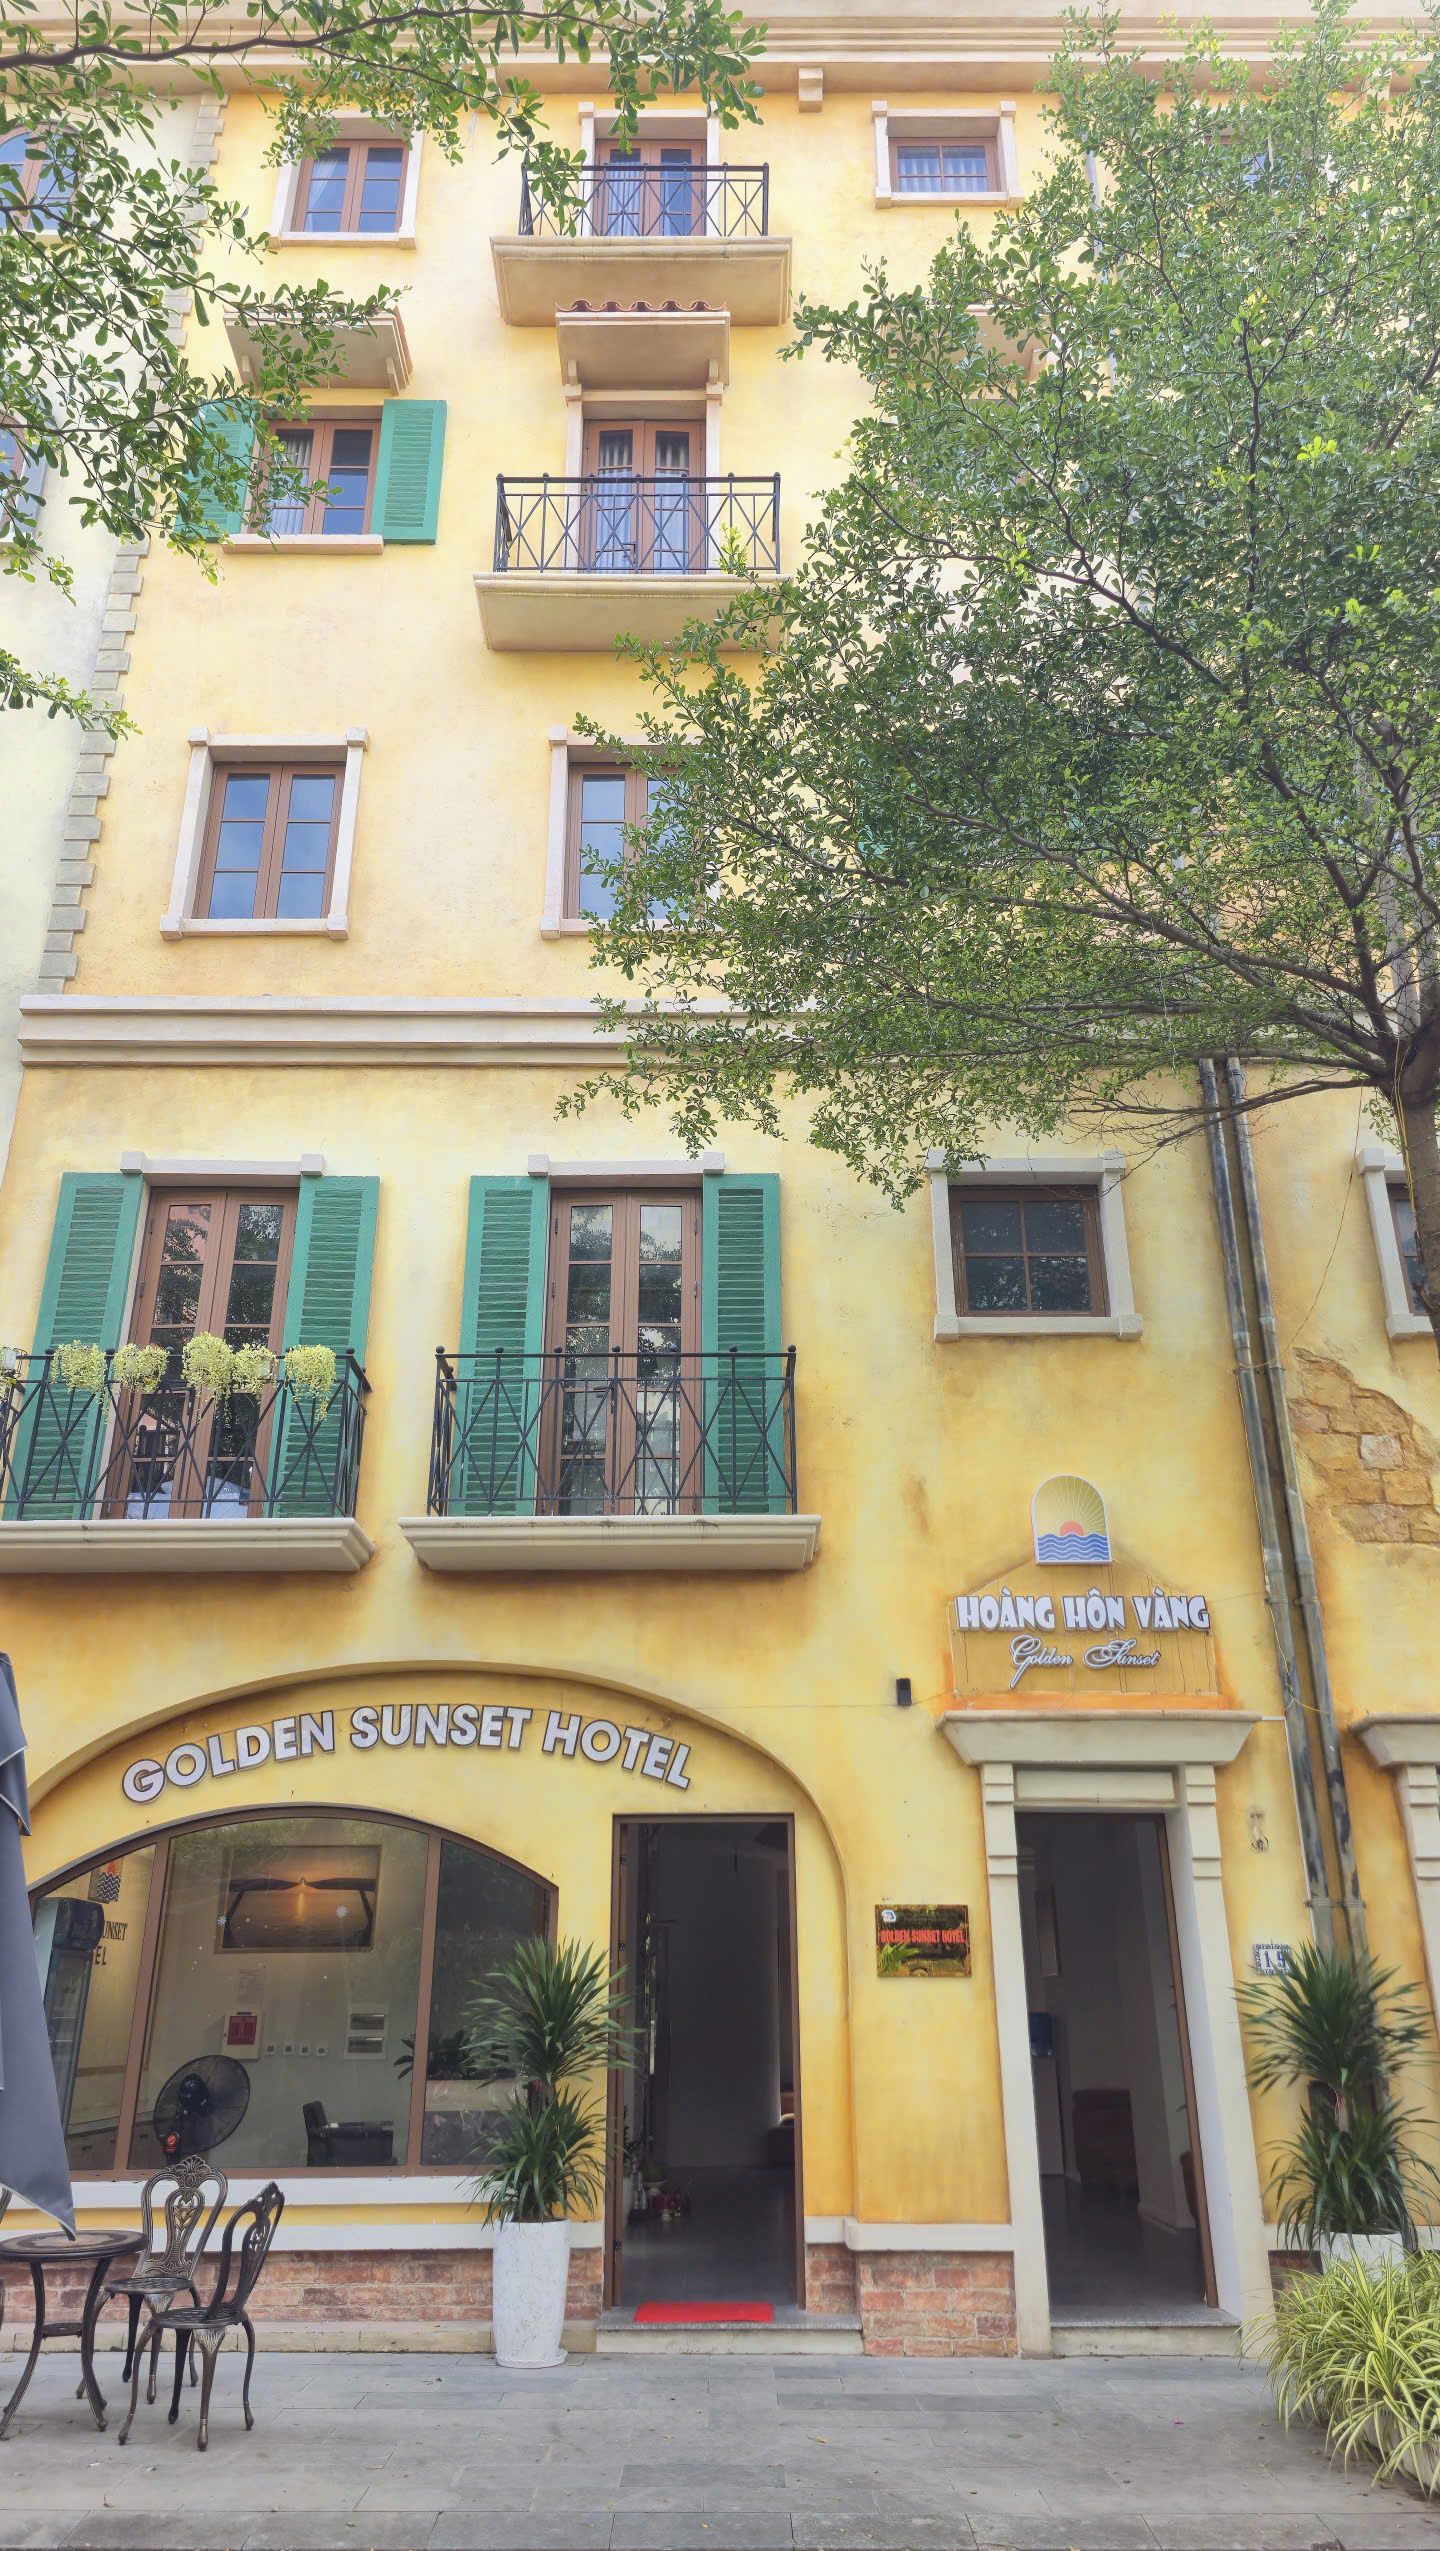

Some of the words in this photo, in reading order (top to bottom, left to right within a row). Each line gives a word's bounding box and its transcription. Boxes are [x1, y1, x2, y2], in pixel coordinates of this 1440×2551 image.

[955, 1587, 1056, 1632] HOÀNG
[1062, 1587, 1126, 1632] HÔN
[1132, 1587, 1211, 1632] VÀNG
[1008, 1634, 1073, 1690] Golden
[1083, 1637, 1162, 1670] Sunset
[121, 1710, 336, 1804] GOLDEN
[350, 1703, 534, 1750] SUNSET
[541, 1710, 692, 1791] HOTEL
[880, 1929, 909, 1943] GOLDEN
[911, 1929, 941, 1943] SUNSET
